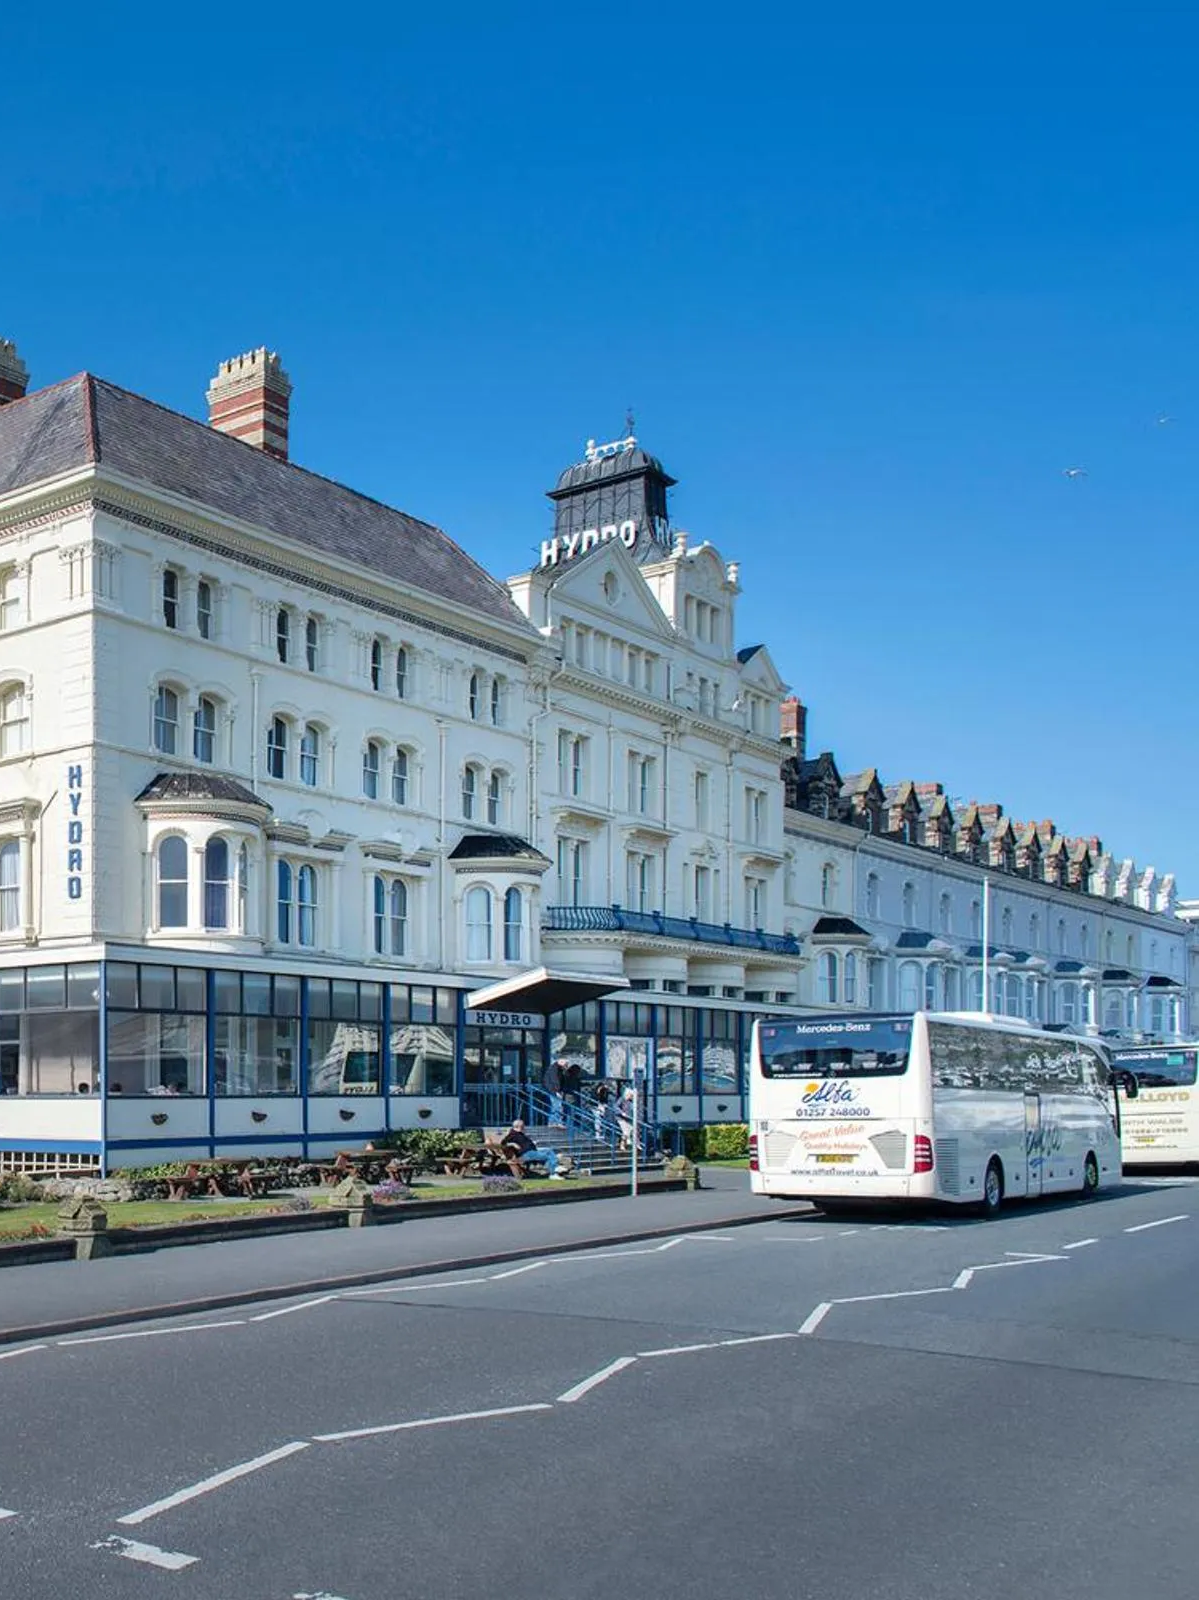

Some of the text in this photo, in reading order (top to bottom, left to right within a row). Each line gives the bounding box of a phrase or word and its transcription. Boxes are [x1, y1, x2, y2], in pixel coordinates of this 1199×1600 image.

[67, 764, 83, 899] HYDRO
[476, 1011, 531, 1026] HYDRO
[796, 1022, 871, 1034] Mercedes-Benz
[802, 1080, 857, 1104] Alfa
[795, 1107, 871, 1117] 01257 248000
